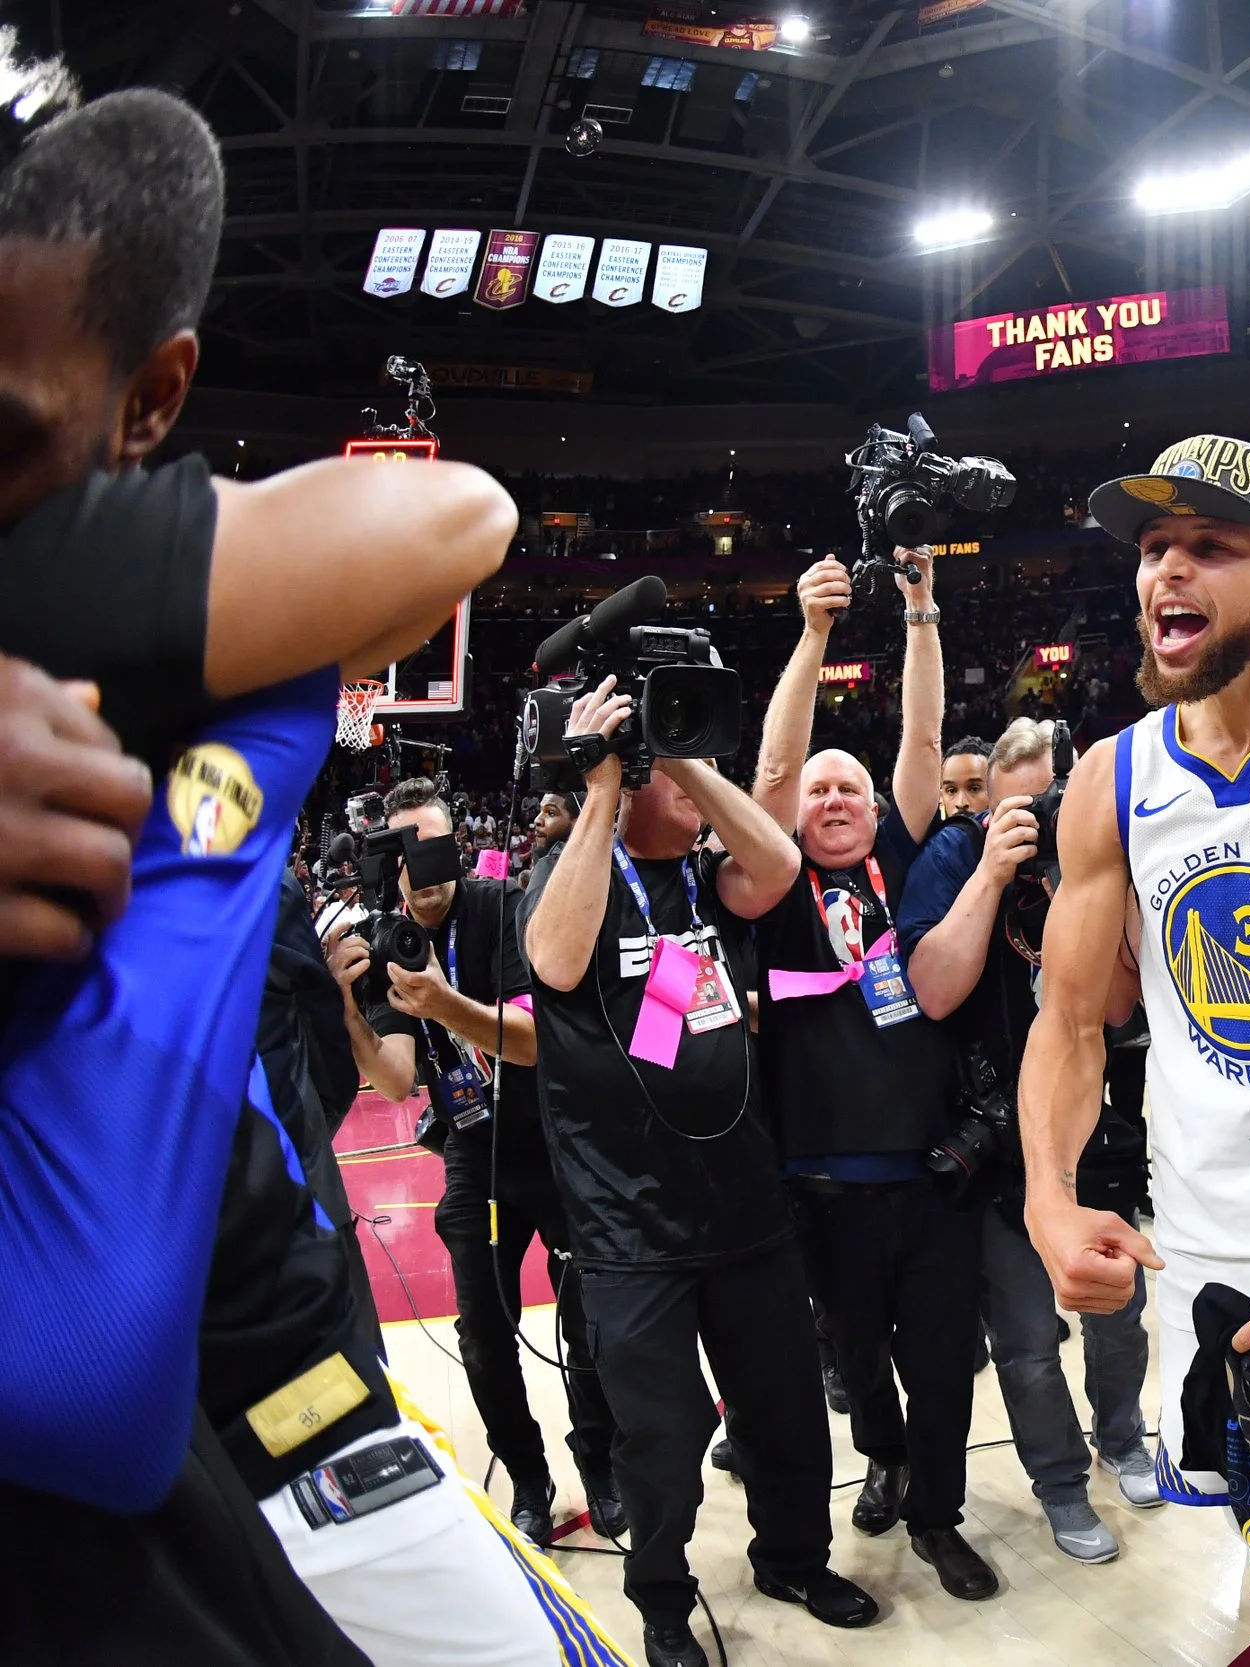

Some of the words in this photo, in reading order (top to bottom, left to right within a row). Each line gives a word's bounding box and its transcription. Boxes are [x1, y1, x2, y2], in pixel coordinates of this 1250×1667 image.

[505, 234, 523, 242] 2016
[382, 246, 412, 254] EASTERN
[438, 247, 469, 255] EASTERN
[503, 246, 518, 255] NBA
[374, 255, 417, 263] CONFERENCE
[430, 255, 474, 264] CONFERENCE
[487, 253, 530, 265] CHAMPIONS
[550, 251, 581, 260] EASTERN
[608, 256, 639, 265] EASTERN
[542, 260, 586, 270] CONFERENCE
[662, 257, 702, 266] CHAMPIONS
[373, 265, 411, 273] CHAMPIONS
[429, 265, 468, 274] CHAMPIONS
[601, 264, 644, 275] CONFERENCE
[542, 270, 582, 280] CHAMPIONS
[600, 274, 640, 284] CHAMPIONS
[986, 307, 1088, 348] THANK
[1096, 298, 1162, 331] YOU
[1034, 335, 1114, 371] FANS
[431, 367, 541, 385] OUDVILLE
[950, 542, 980, 555] FANS
[1040, 645, 1069, 662] YOU
[819, 664, 863, 682] THANK
[1150, 841, 1241, 912] GOLDEN
